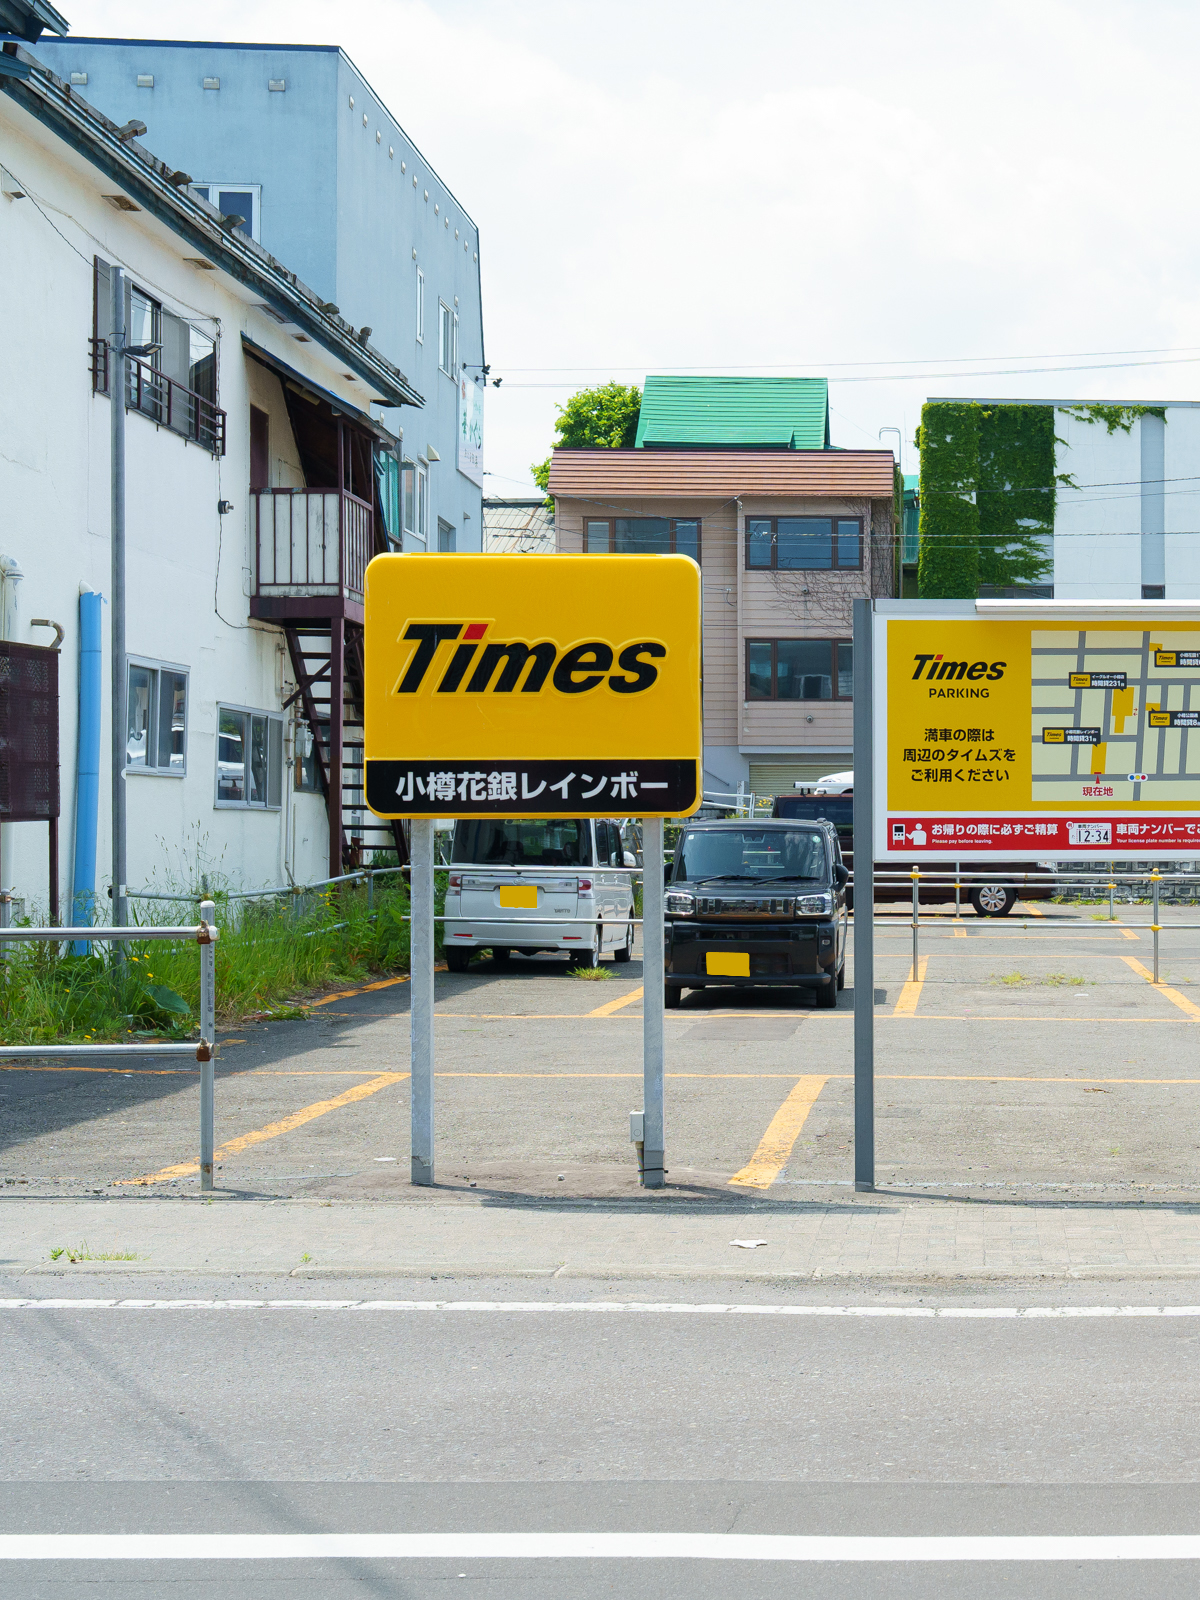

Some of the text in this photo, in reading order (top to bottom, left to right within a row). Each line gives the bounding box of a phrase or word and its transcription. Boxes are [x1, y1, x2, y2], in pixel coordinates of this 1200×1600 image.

[397, 623, 667, 694] Times
[911, 654, 1007, 681] Times
[928, 688, 990, 698] PARKING
[924, 728, 995, 743] 満車の際は
[903, 748, 1016, 763] 周辺のタイムズを
[911, 768, 1010, 783] ご利用ください
[395, 771, 668, 801] 小樽花銀レインボー
[1082, 786, 1114, 798] 現在地
[931, 823, 1059, 836] お帰りの際に必ずご精算
